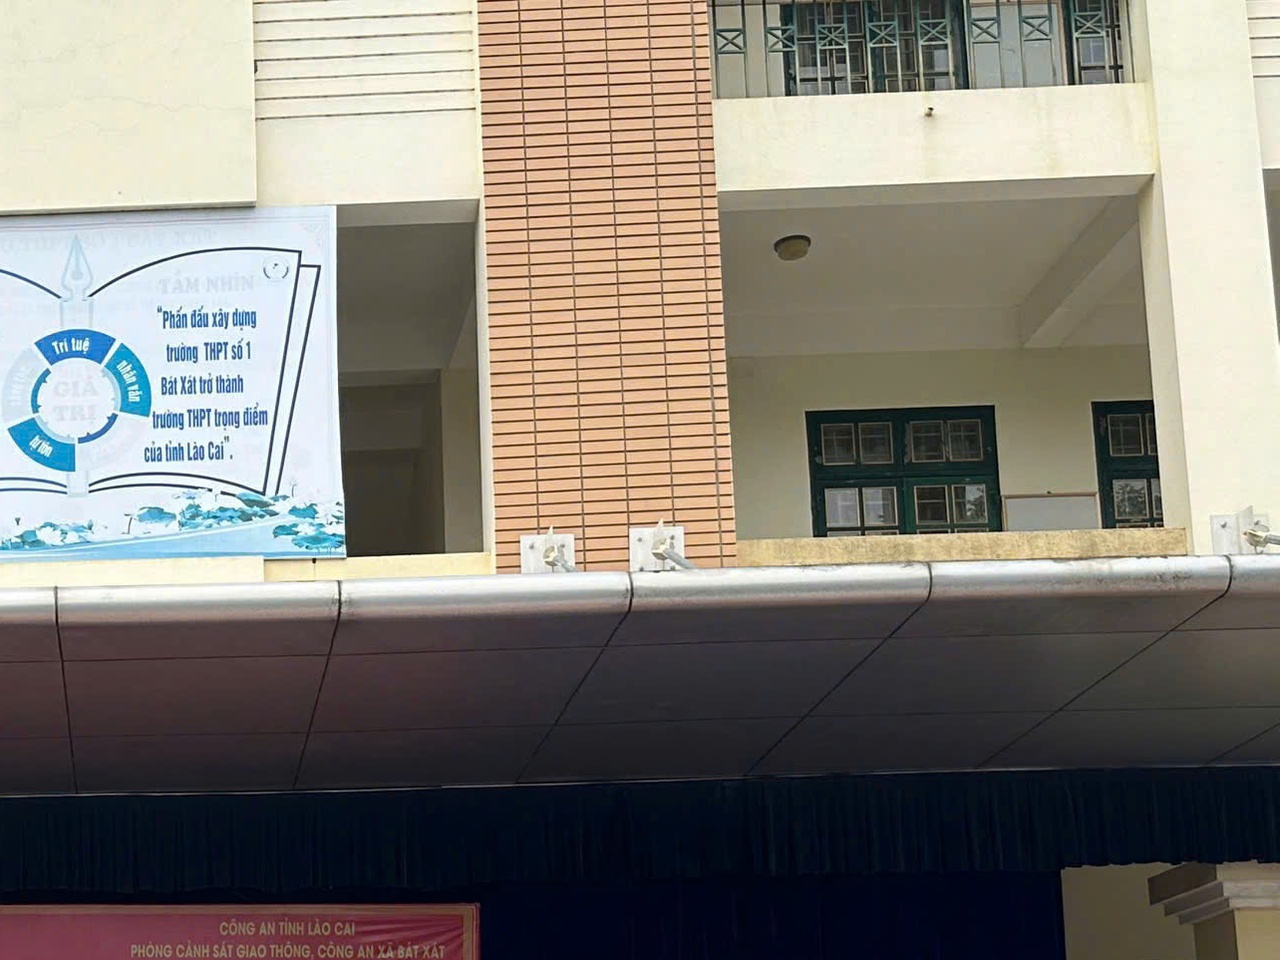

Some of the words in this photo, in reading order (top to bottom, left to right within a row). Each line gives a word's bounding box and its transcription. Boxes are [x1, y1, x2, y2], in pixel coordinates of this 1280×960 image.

[190, 305, 209, 328] đấu
[212, 308, 230, 330] xây
[232, 307, 257, 331] dựng
[52, 338, 68, 355] Trí
[72, 337, 90, 355] tuệ
[166, 342, 198, 364] trường
[204, 342, 229, 361] THPT
[231, 337, 244, 360] số
[246, 341, 251, 360] 1
[161, 376, 177, 395] Bát
[180, 375, 197, 395] Xát
[199, 372, 214, 394] trở
[216, 374, 244, 394] thành
[152, 409, 184, 430] trường
[187, 408, 212, 428] THPT
[214, 408, 240, 431] trọng
[243, 402, 268, 426] điểm
[144, 441, 162, 463] của
[165, 440, 184, 462] tỉnh
[187, 441, 205, 461] Lào
[220, 918, 256, 937] CÔNG
[258, 922, 276, 936] AN
[278, 917, 305, 936] TỈNH
[308, 918, 331, 936] LÀO
[334, 922, 355, 936] CAI
[130, 941, 172, 959] PHÒNG
[175, 940, 210, 959] CẢNH
[212, 940, 234, 959] SÁT
[236, 945, 268, 959] GIAO
[317, 941, 355, 959] CÔNG
[357, 945, 376, 959] AN
[377, 941, 395, 959] XÃ
[397, 941, 420, 959] BÁT
[422, 941, 446, 959] XÁT
